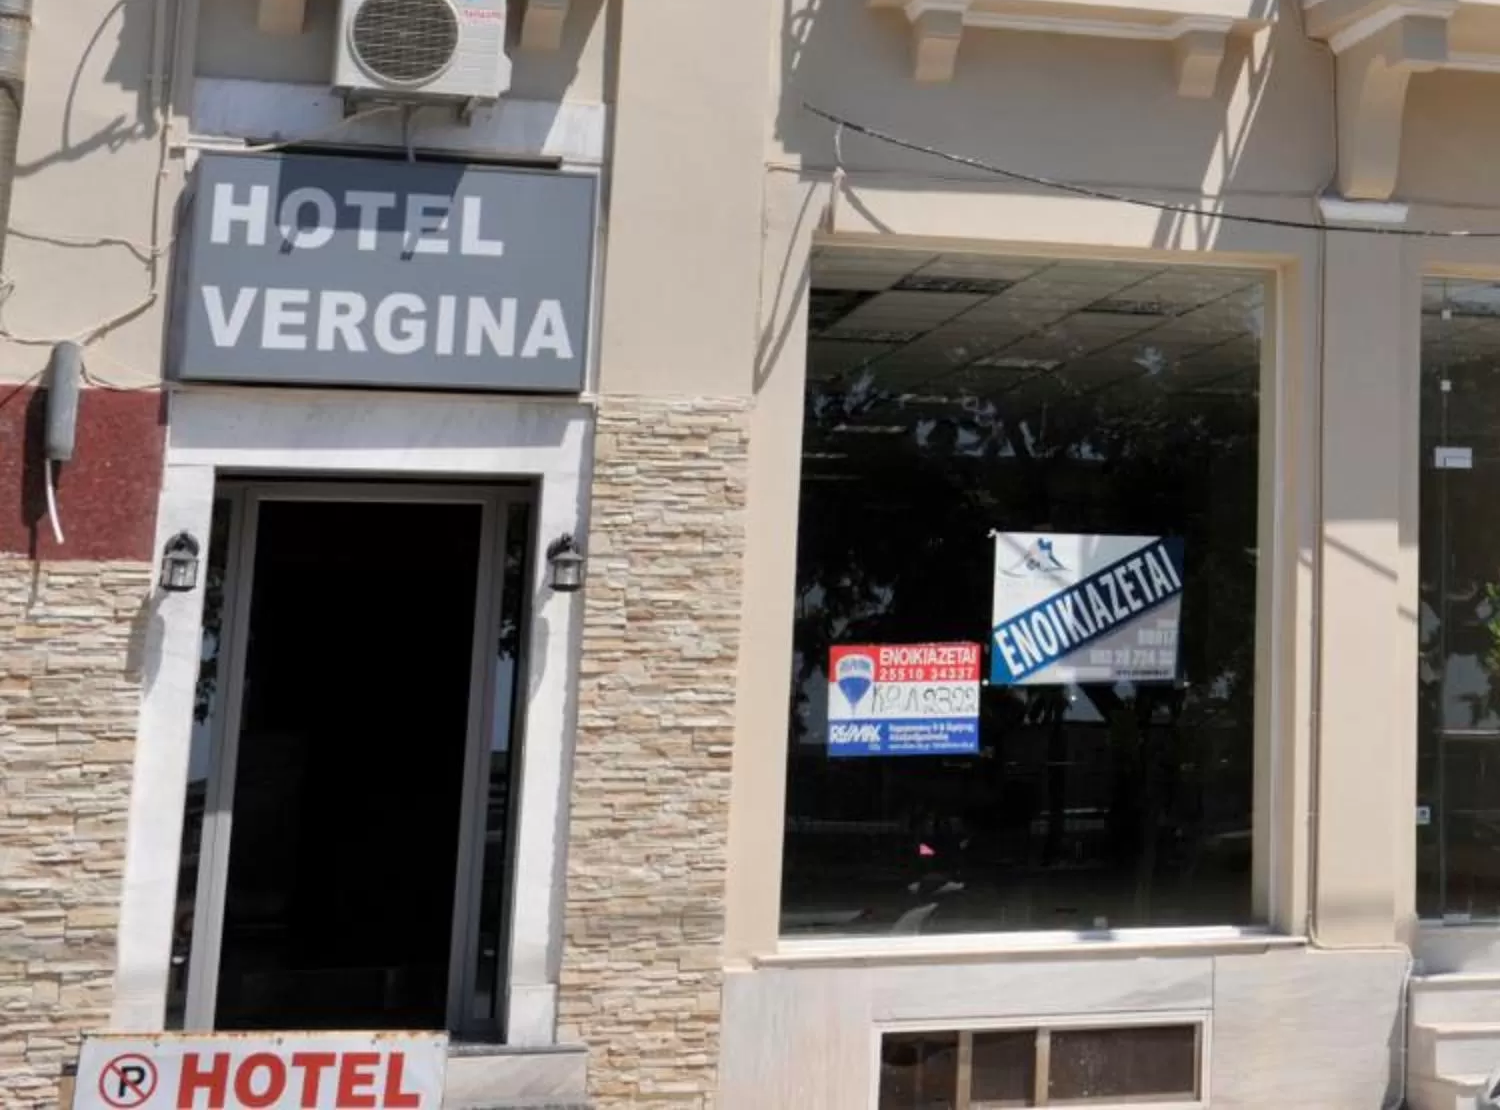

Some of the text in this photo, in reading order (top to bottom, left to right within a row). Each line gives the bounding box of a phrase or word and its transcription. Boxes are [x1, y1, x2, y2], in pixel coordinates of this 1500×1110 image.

[209, 182, 504, 257] HOTEL
[201, 285, 574, 360] VERGINA
[994, 544, 1182, 676] ΕΝΟΙΚΙΑΖΕΤΑΙ
[879, 646, 977, 666] ΕΝΟΙΚΙΑΖΕΤΑΙ
[176, 1052, 420, 1109] HOTEL
